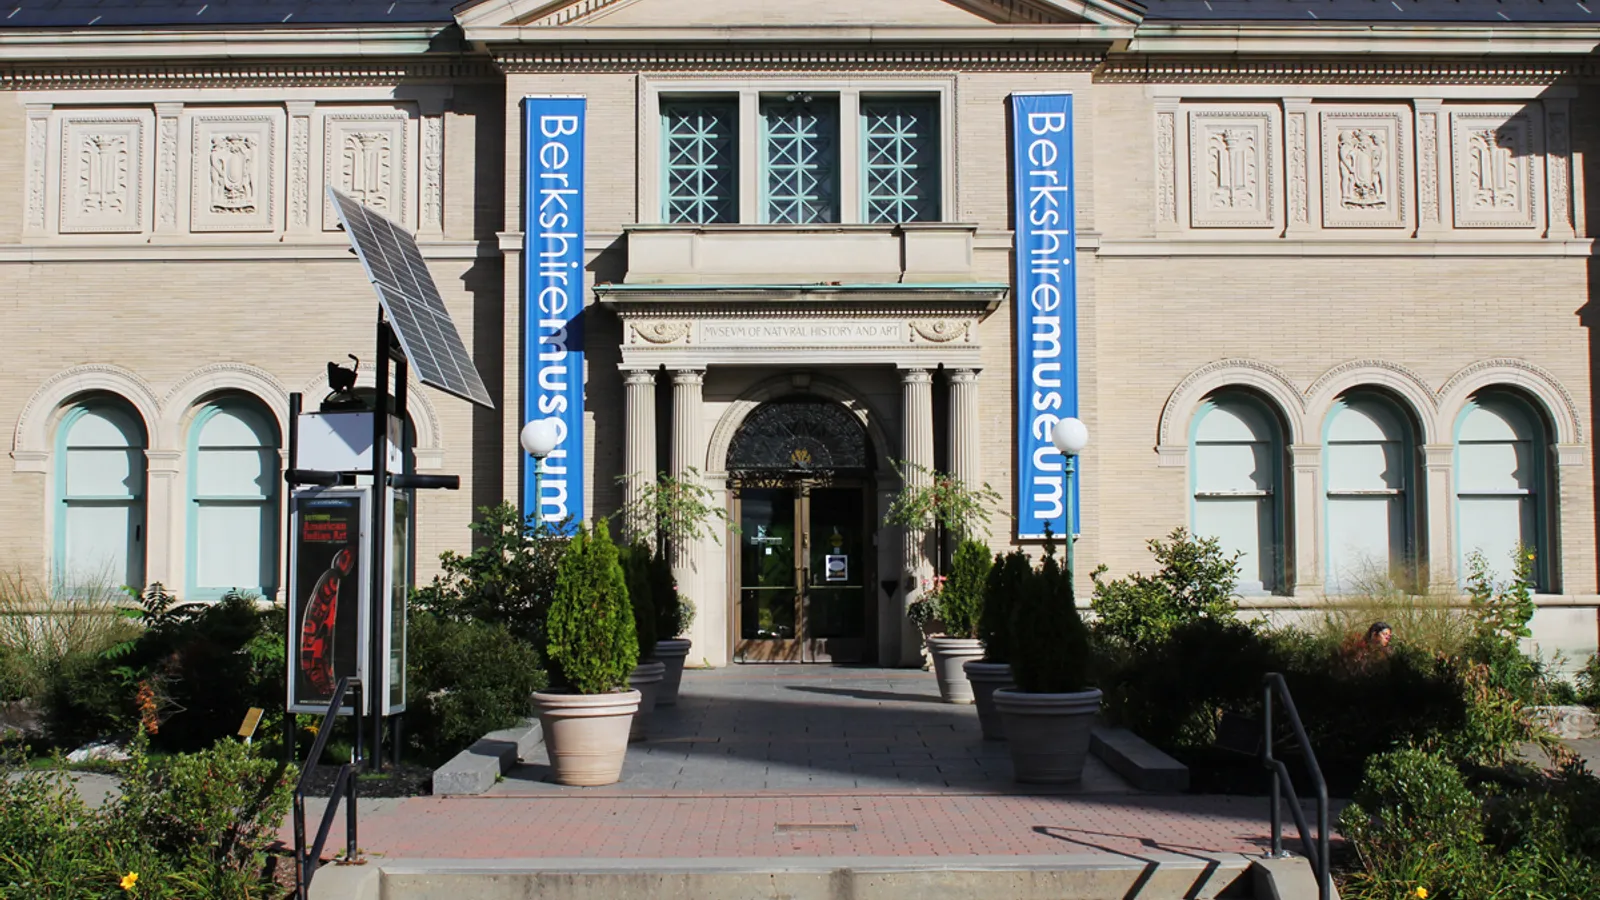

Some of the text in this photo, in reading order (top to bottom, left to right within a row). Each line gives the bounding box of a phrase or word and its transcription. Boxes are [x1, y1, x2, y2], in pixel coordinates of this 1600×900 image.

[704, 325, 899, 337] MVSEVM OF NATVRAL HISTORY AND ART
[304, 522, 347, 530] American
[304, 531, 347, 540] Indian Art
